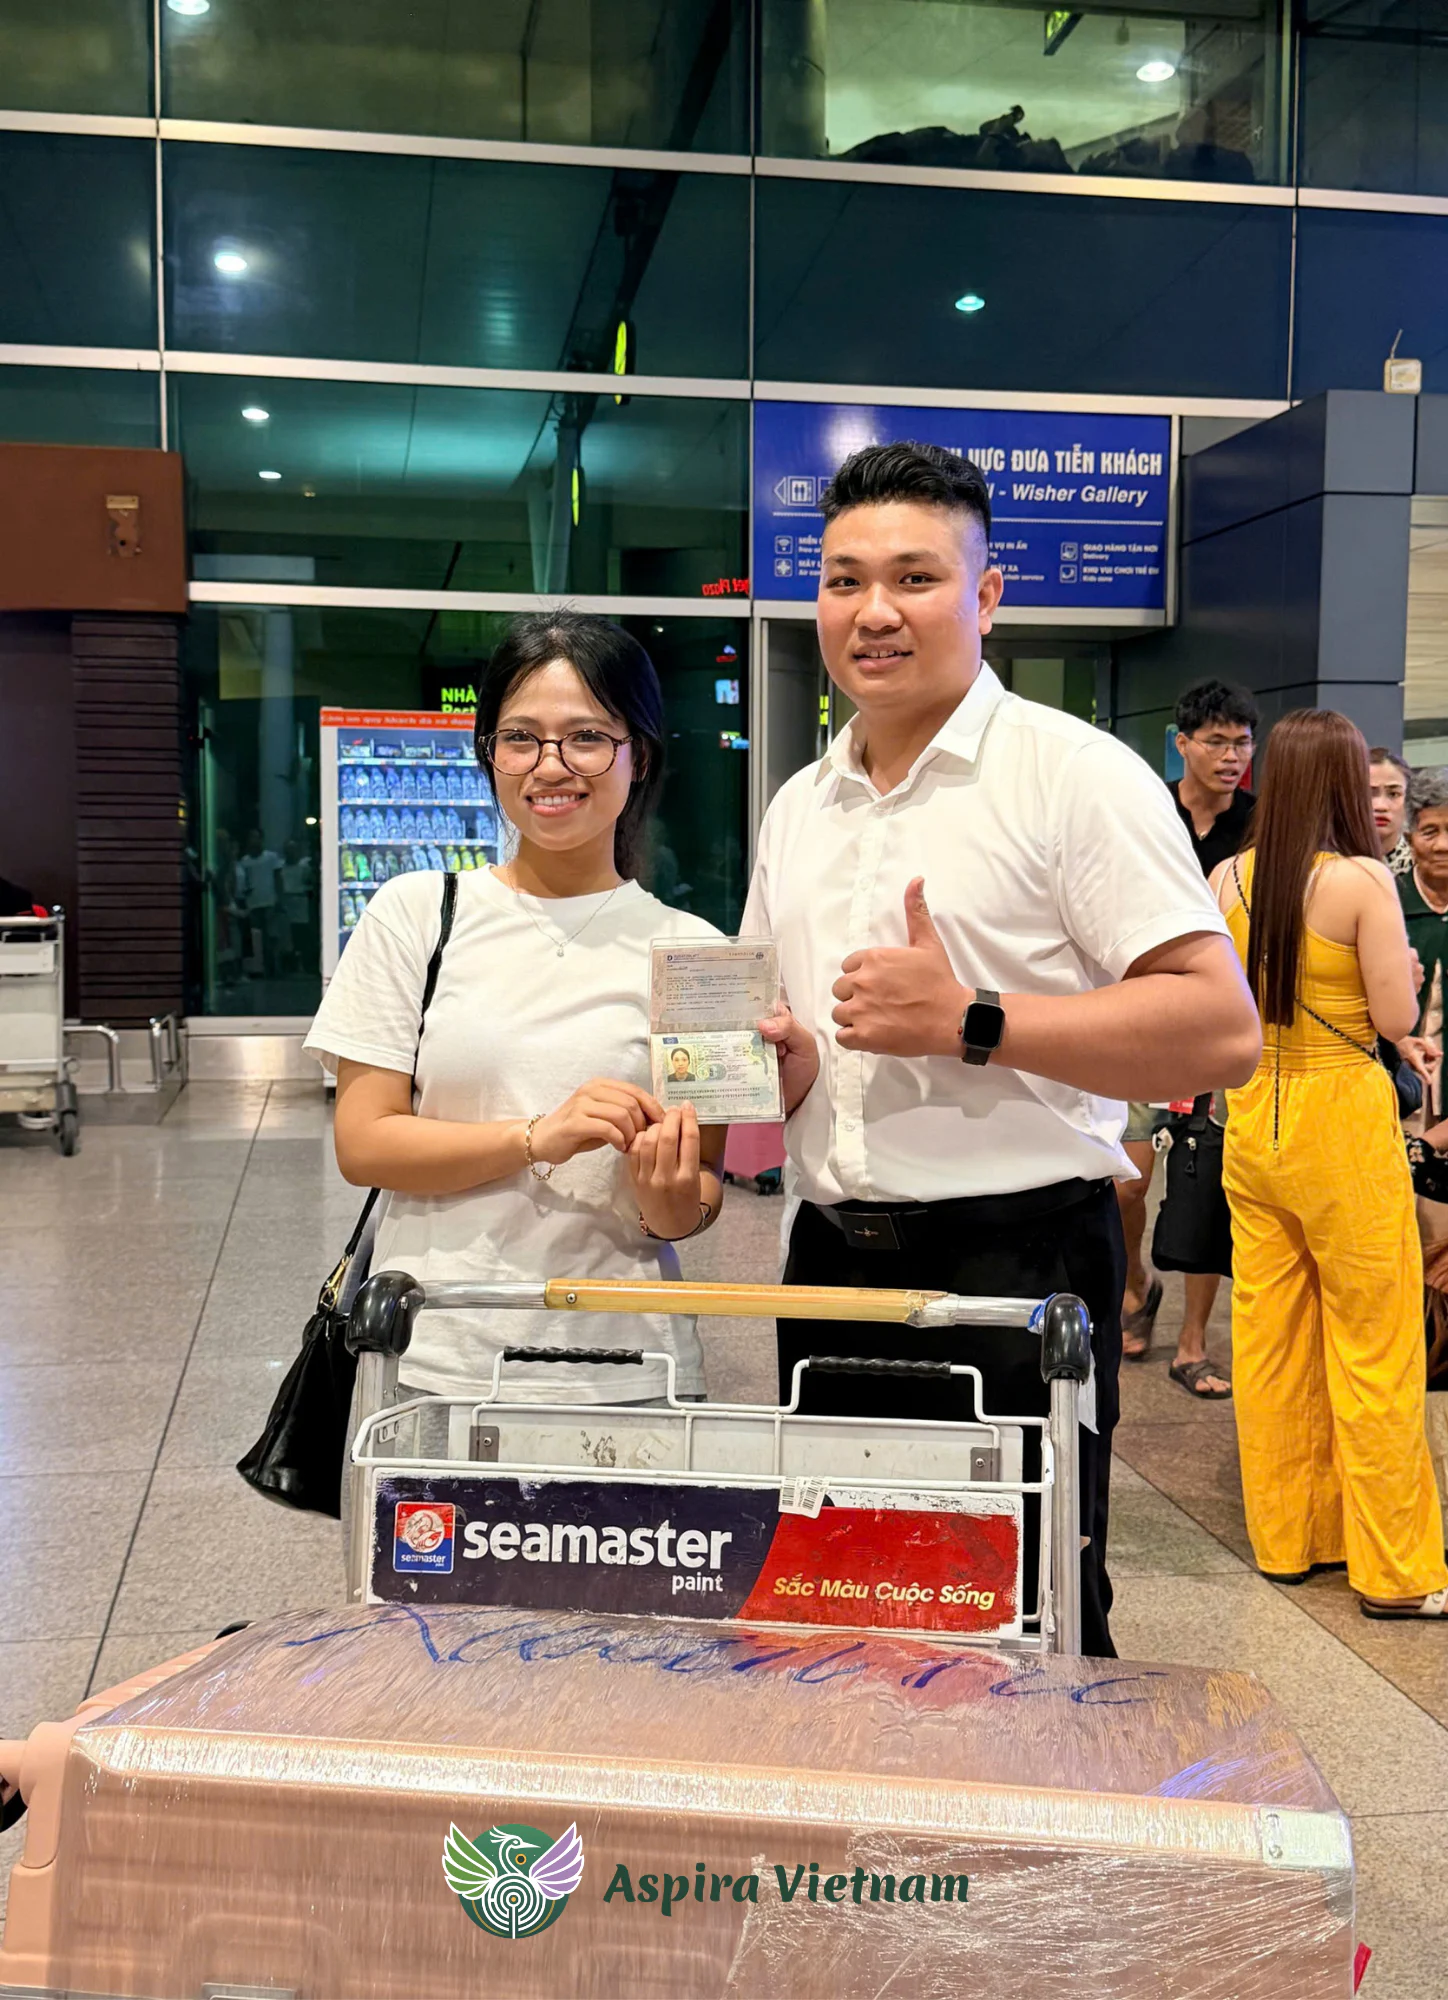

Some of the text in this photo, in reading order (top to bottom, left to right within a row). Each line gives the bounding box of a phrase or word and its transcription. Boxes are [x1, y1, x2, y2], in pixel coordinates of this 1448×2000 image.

[1011, 448, 1049, 473] ĐƯA
[1054, 443, 1094, 474] TIỄN
[1101, 448, 1162, 476] KHÁCH
[1012, 483, 1076, 502] Wisher
[1081, 485, 1148, 507] Gallery
[441, 684, 477, 703] NHÀ
[462, 1519, 733, 1570] seamaster
[401, 1554, 447, 1563] seamaster
[672, 1573, 724, 1596] paint
[772, 1572, 995, 1611] Sắc Màu Cuộc Sống
